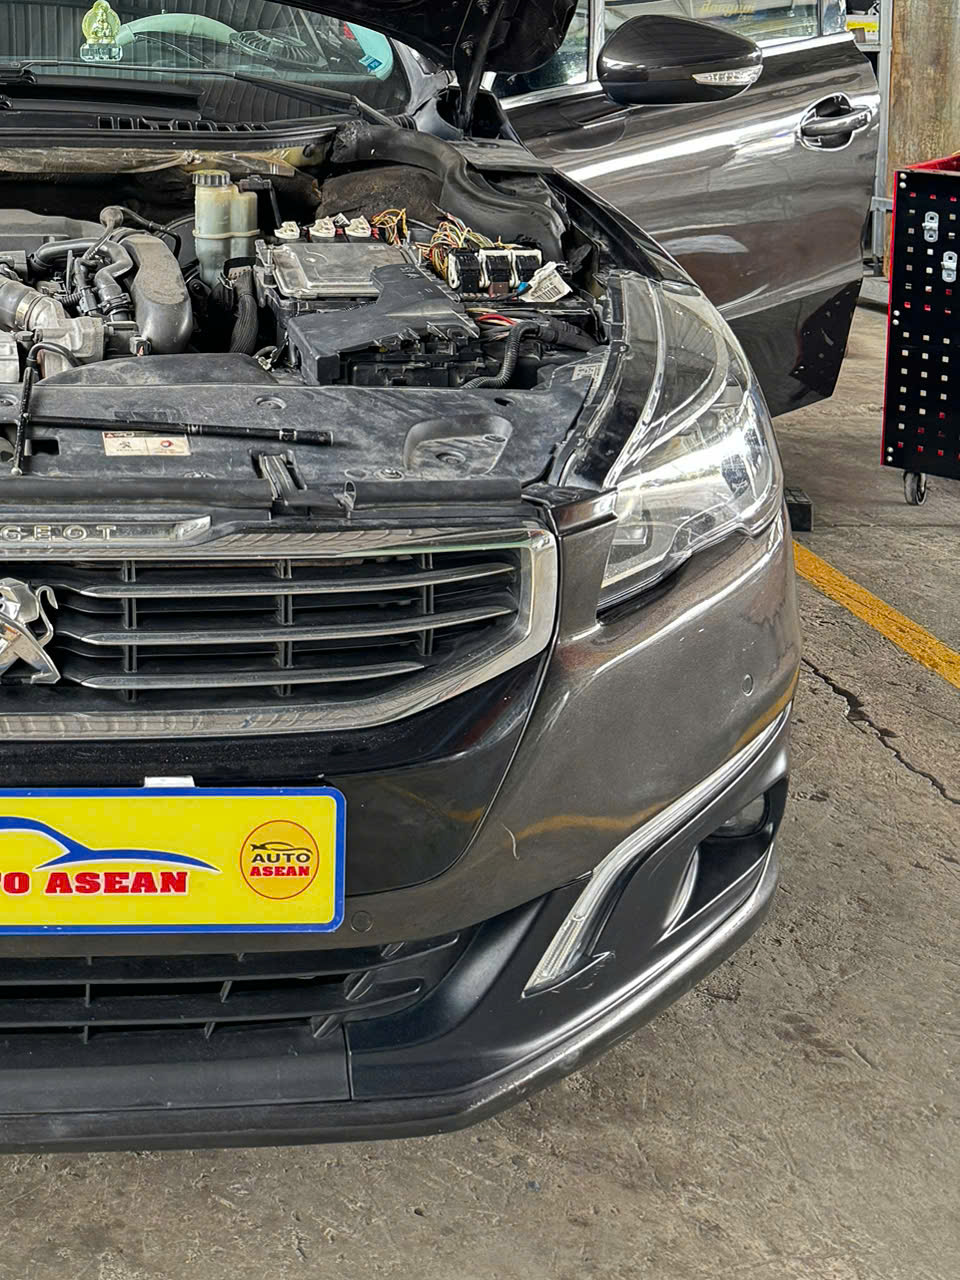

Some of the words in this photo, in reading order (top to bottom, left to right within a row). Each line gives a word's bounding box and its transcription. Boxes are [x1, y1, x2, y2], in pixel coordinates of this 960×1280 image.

[251, 853, 311, 863] AUTO
[250, 866, 310, 877] ASEAN
[44, 870, 188, 895] ASEAN
